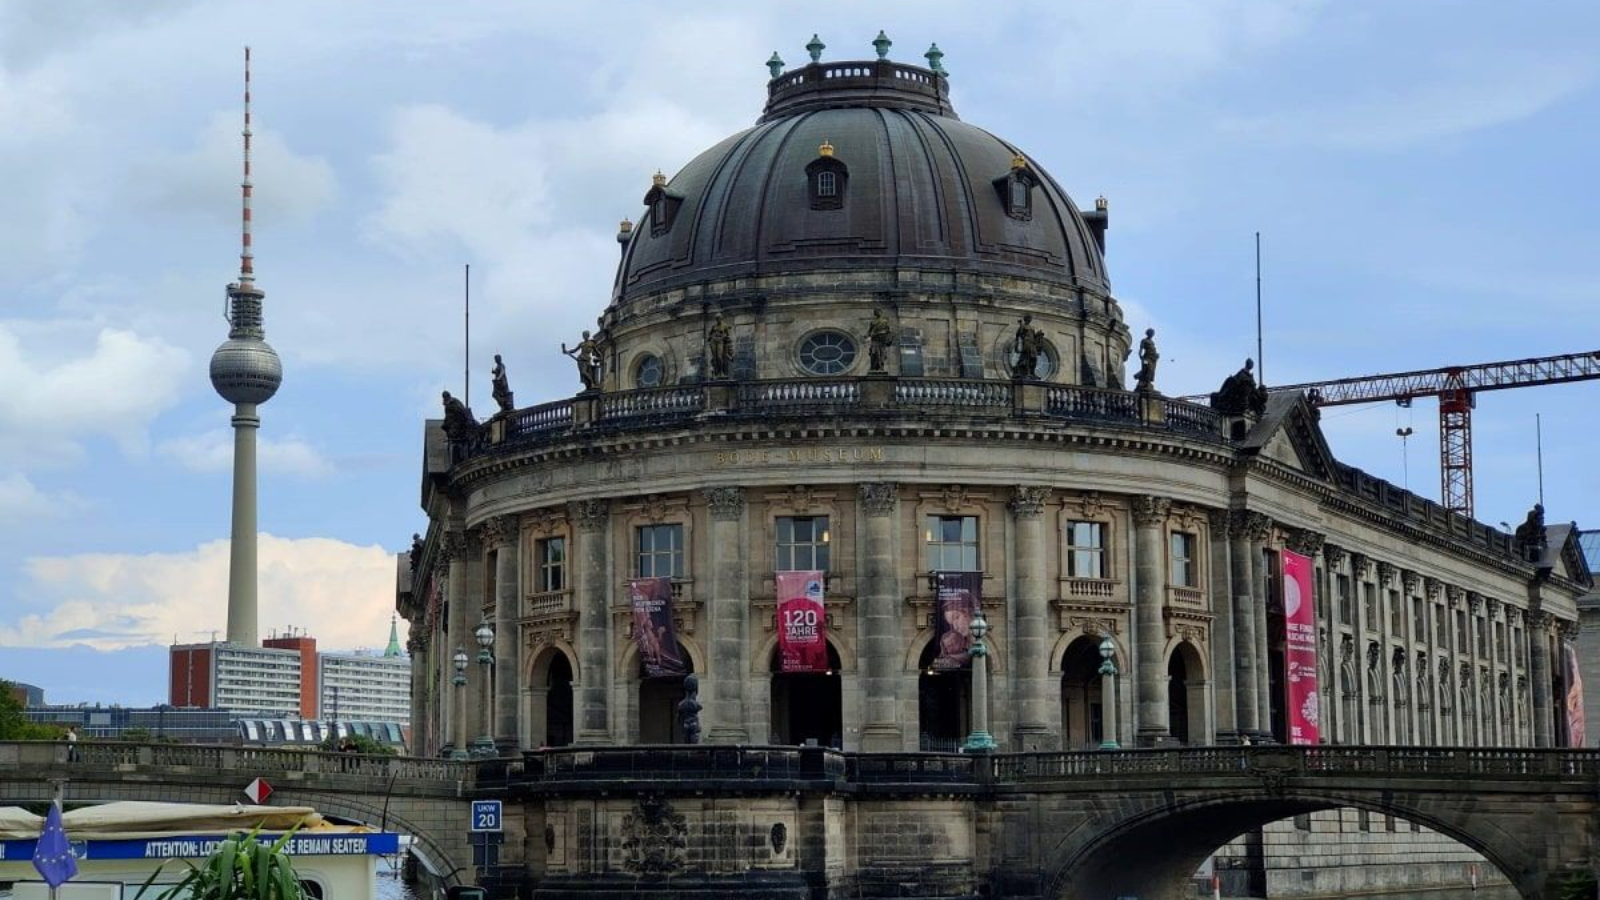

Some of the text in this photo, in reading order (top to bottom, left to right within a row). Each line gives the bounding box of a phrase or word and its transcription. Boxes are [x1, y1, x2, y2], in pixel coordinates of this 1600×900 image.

[784, 610, 817, 626] 120
[786, 626, 818, 636] JAHRE
[479, 814, 495, 827] 20
[145, 841, 198, 857] ATTENTION:
[297, 839, 330, 854] REMAIN
[332, 838, 367, 854] SEATED!
